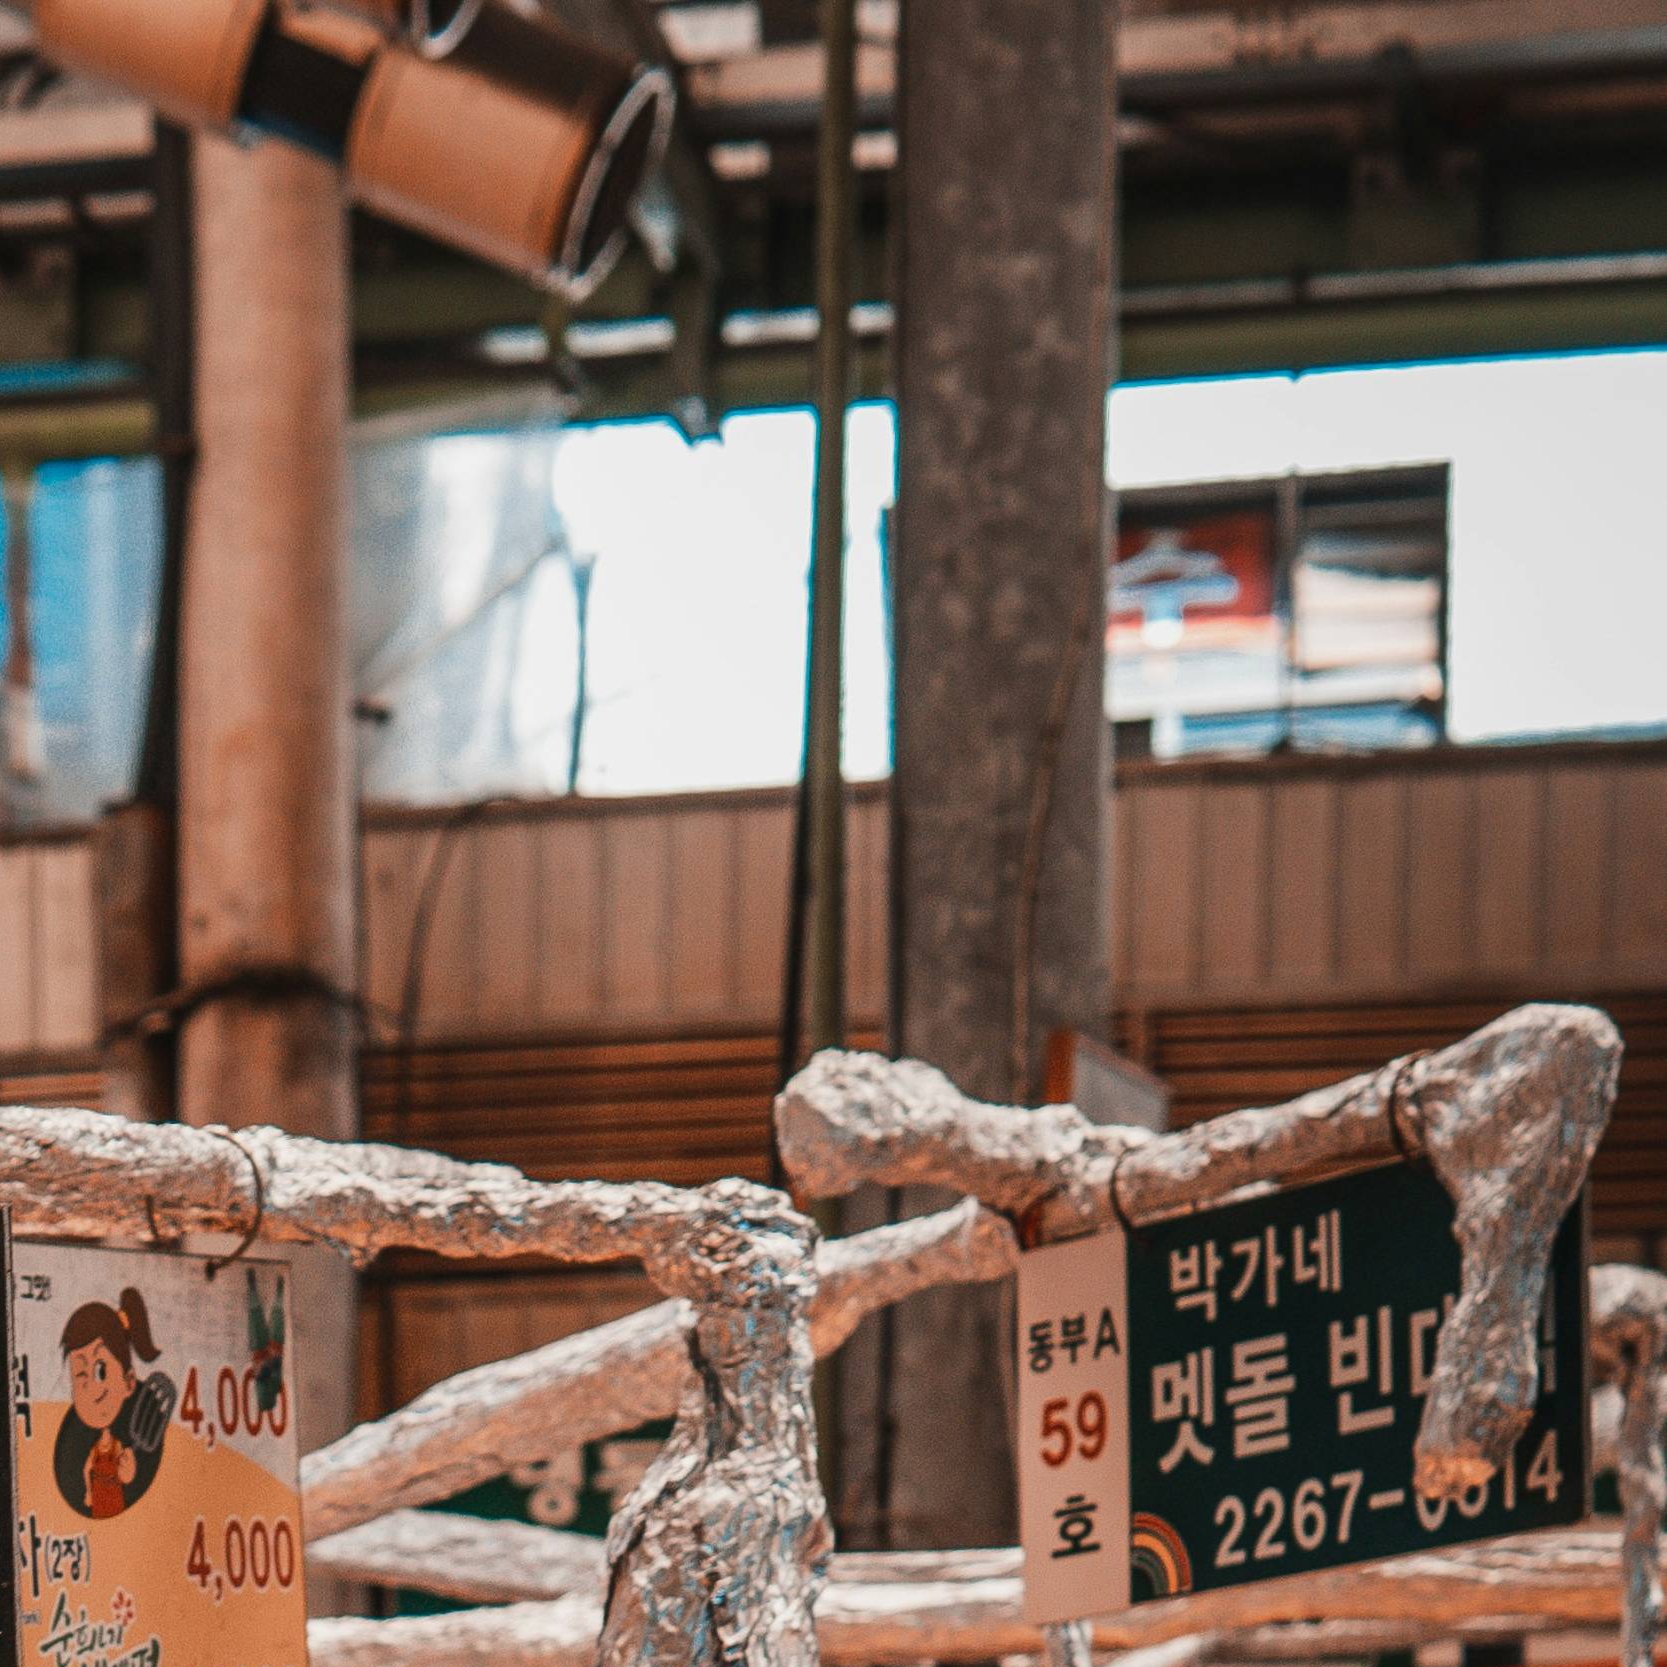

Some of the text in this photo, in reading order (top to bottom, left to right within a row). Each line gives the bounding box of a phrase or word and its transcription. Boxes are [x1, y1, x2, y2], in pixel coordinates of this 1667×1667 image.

[1169, 1209, 1343, 1322] 박가네
[1026, 1306, 1121, 1373] 동부A
[1040, 1390, 1108, 1469] 59
[1151, 1332, 1296, 1476] 멧돌
[187, 1520, 294, 1600] 4,000
[1050, 1494, 1101, 1559] 호
